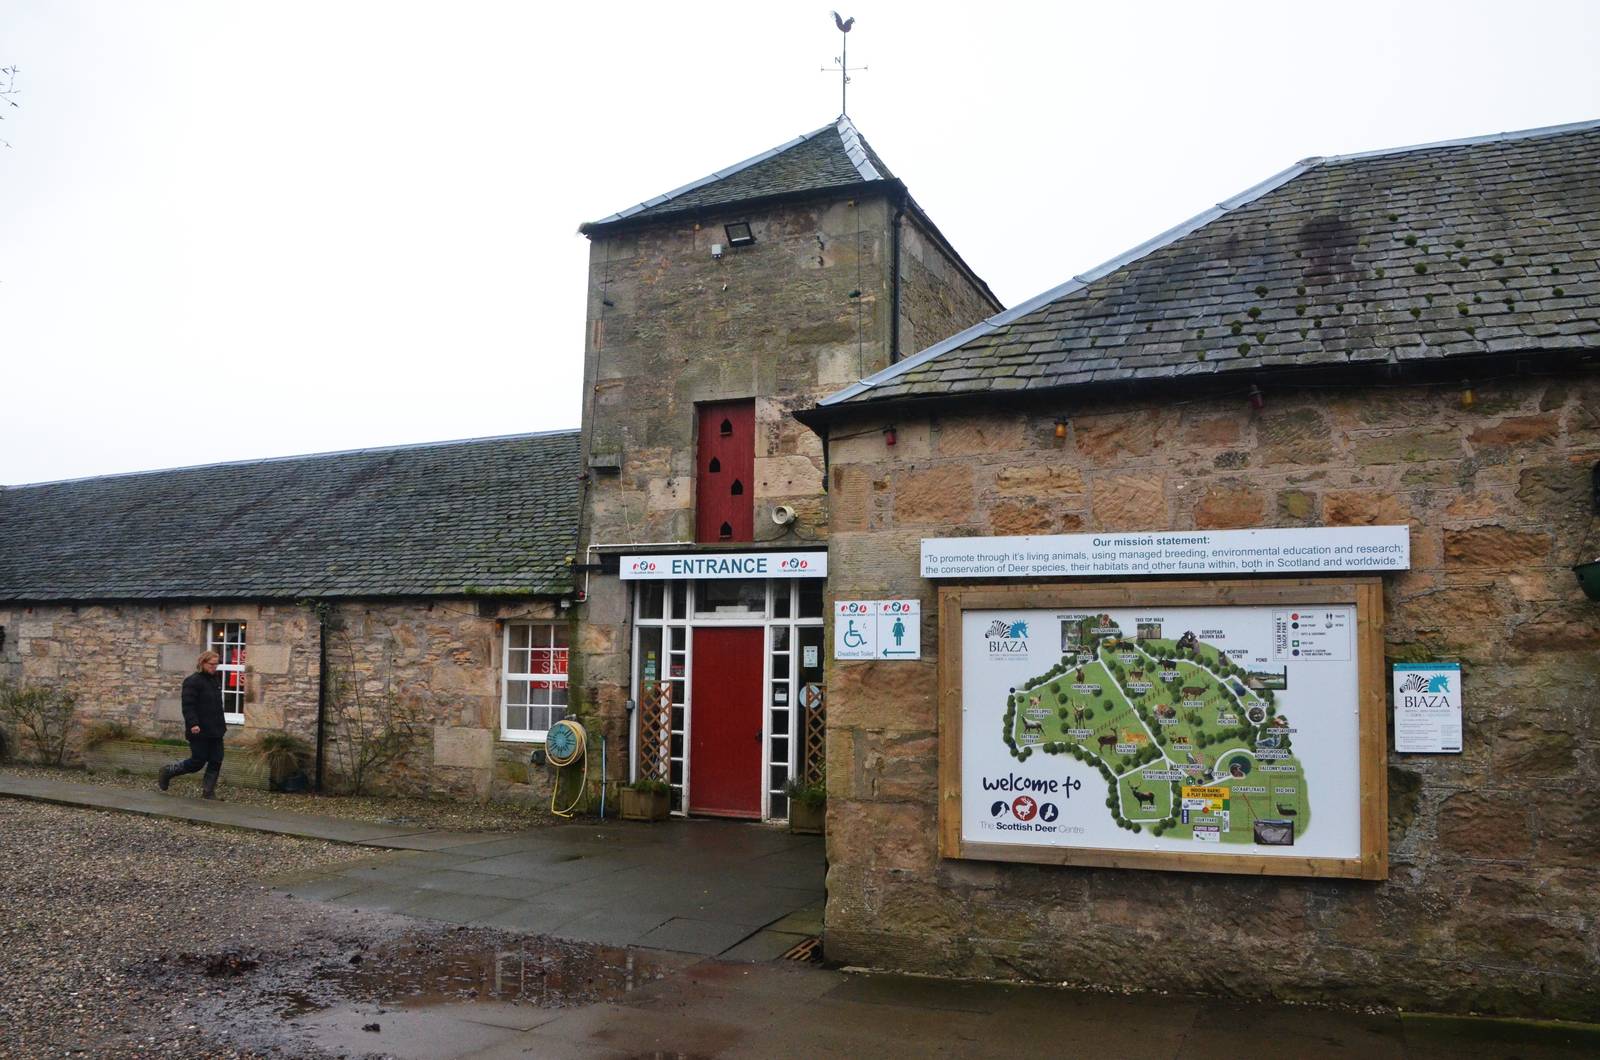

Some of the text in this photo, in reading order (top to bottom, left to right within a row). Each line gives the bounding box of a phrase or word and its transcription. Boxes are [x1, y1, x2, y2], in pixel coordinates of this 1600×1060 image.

[1093, 536, 1211, 547] Our mission statement:
[940, 554, 975, 564] promote
[977, 553, 1010, 563] through
[1027, 552, 1050, 562] living
[1052, 551, 1089, 562] animals,
[1092, 551, 1117, 561] using
[1120, 550, 1162, 561] managed
[1165, 549, 1209, 559] breeding,
[1212, 547, 1280, 556] environmental
[1283, 546, 1331, 555] education
[1335, 545, 1353, 554] and
[672, 558, 768, 574] ENTRANCE
[925, 565, 939, 574] the
[941, 565, 994, 574] conservation
[997, 563, 1006, 572] of
[1008, 563, 1029, 572] Deer
[1031, 563, 1068, 573] species,
[1070, 562, 1090, 571] their
[1093, 562, 1129, 571] habitats
[1131, 561, 1149, 570] and
[1151, 561, 1177, 570] other
[1178, 560, 1205, 569] fauna
[1208, 559, 1239, 569] within,
[1241, 558, 1263, 568] both
[1265, 558, 1275, 567] in
[1277, 557, 1320, 567] Scotland
[1323, 557, 1342, 566] and
[989, 641, 1028, 652] BIAZA
[1404, 696, 1450, 708] BIAZA
[983, 773, 1081, 799] welcome to
[996, 821, 1033, 832] Scottish
[1034, 823, 1057, 833] Deer
